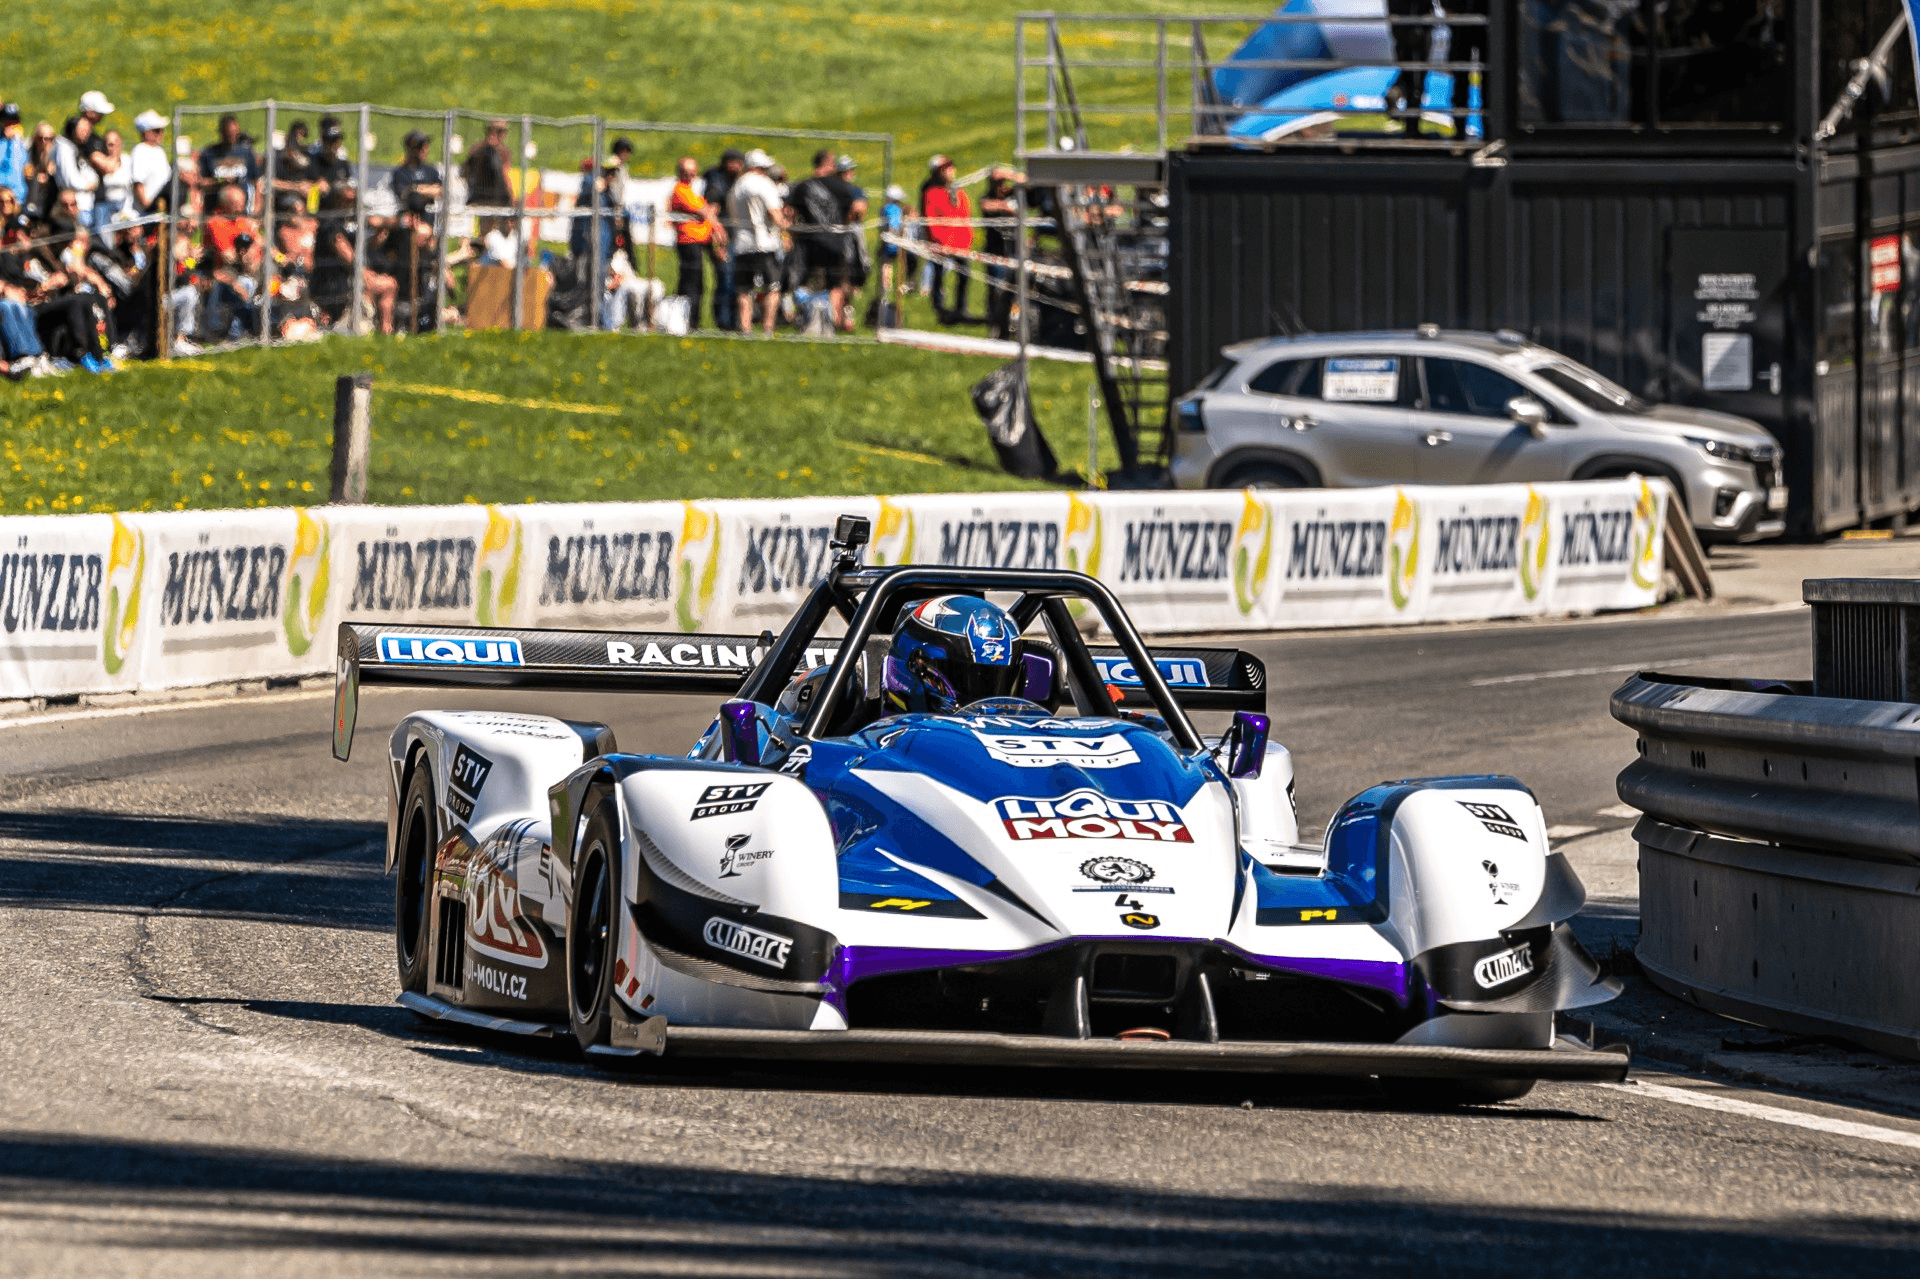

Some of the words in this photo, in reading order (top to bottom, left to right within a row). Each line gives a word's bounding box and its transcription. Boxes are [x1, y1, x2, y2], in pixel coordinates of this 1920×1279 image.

[1119, 506, 1233, 582] MÜNZER
[1286, 507, 1387, 581] MÜNZER
[1434, 504, 1519, 573] MÜNZER
[347, 523, 476, 612] MÜNZER
[539, 518, 675, 606] MÜNZER
[160, 532, 286, 627] MÜNZER
[387, 639, 513, 664] LIQUI
[995, 739, 1105, 751] STV
[454, 753, 486, 788] STV
[705, 785, 765, 800] STV
[1003, 791, 1176, 823] LIQUI
[697, 803, 751, 817] GROUP
[1464, 803, 1508, 820] STV
[1012, 816, 1185, 842] MOLY
[738, 850, 775, 861] WINERY
[1115, 894, 1144, 911] 4
